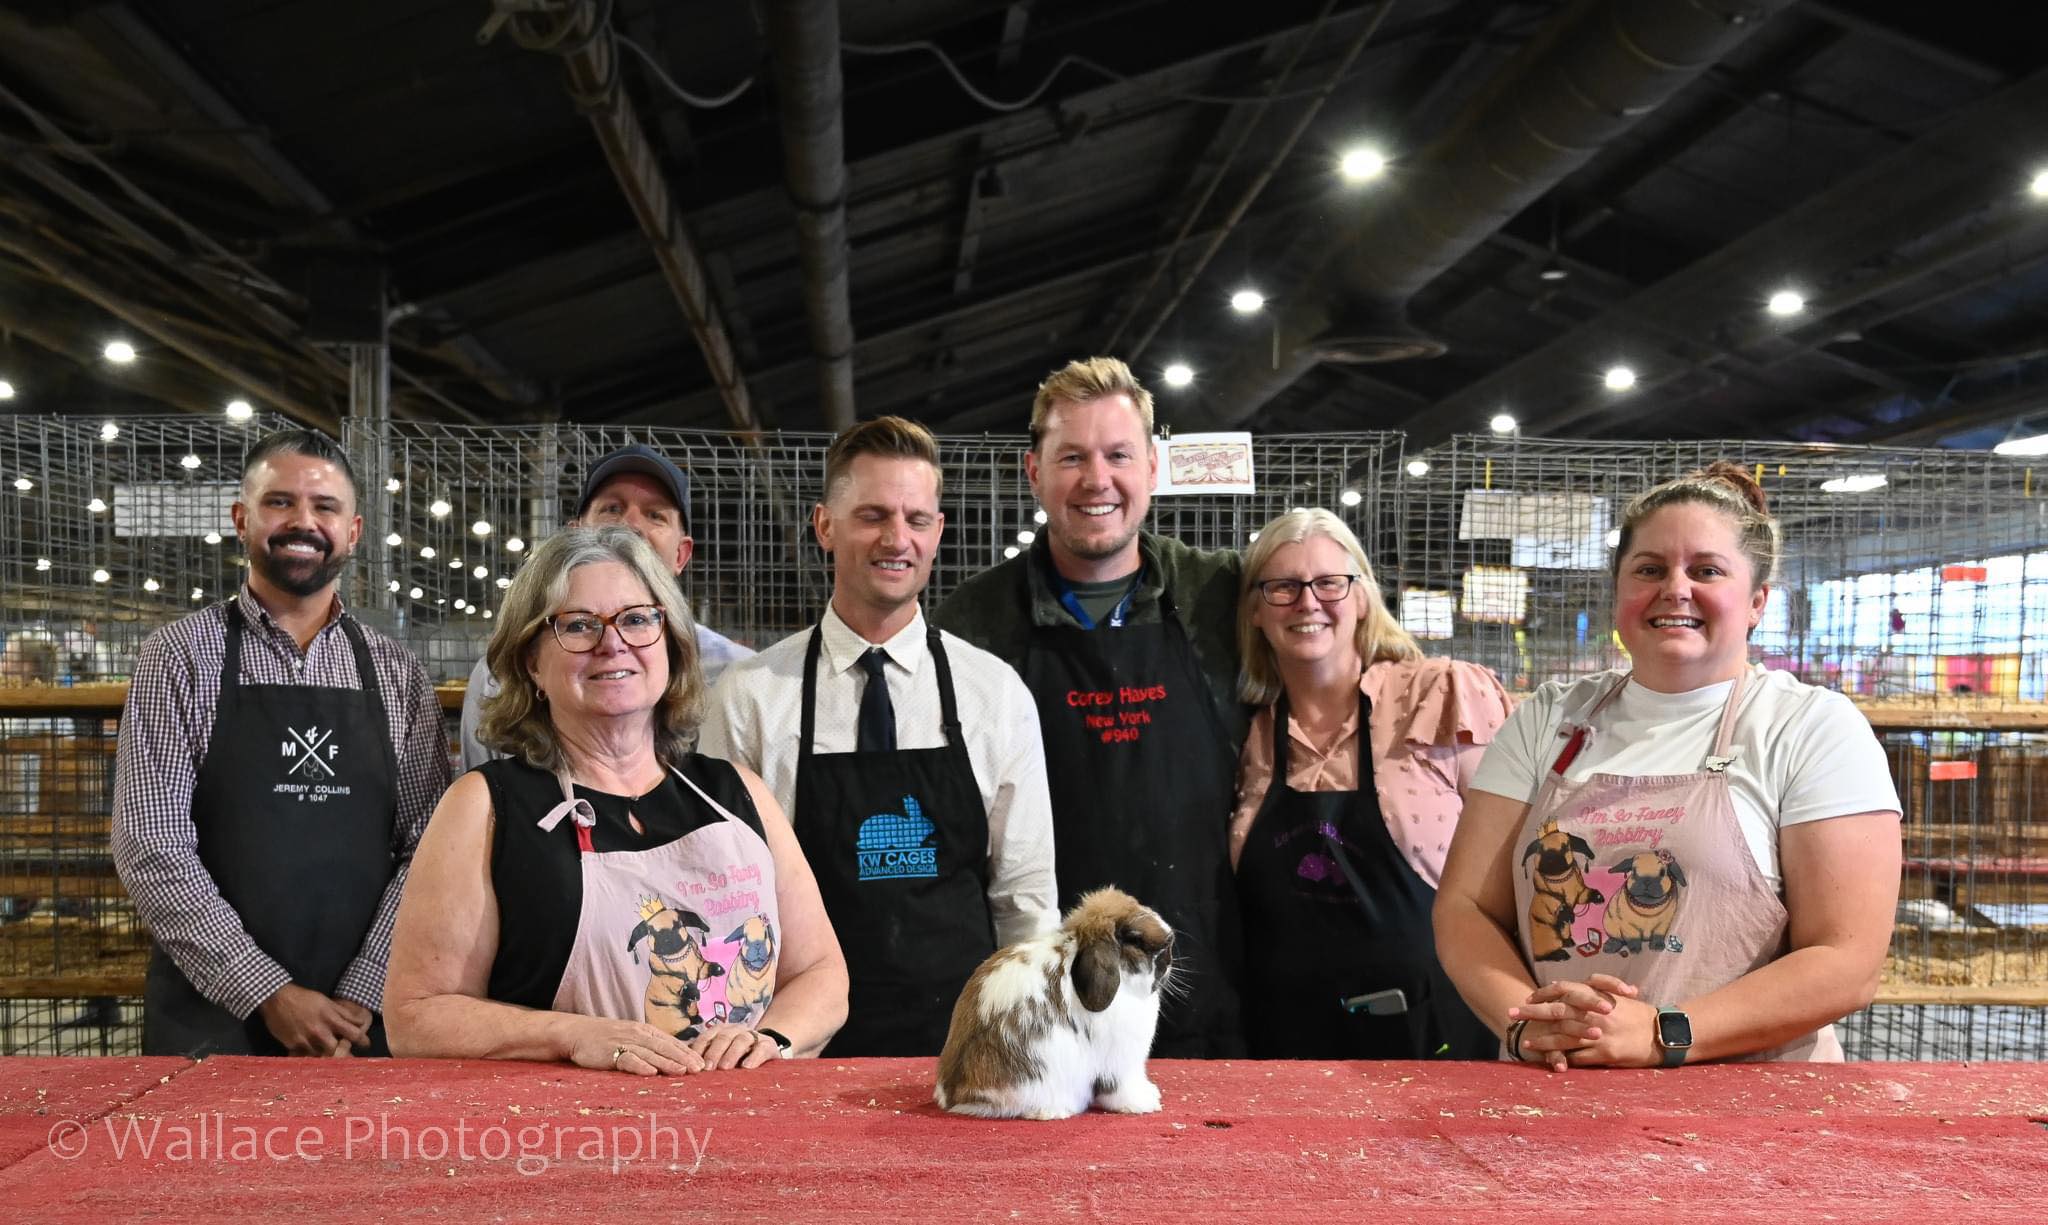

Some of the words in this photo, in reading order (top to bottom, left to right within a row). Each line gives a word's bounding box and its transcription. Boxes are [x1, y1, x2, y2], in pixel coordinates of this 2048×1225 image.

[1067, 690, 1113, 706] Corey
[1119, 685, 1166, 704] Hayes
[1086, 715, 1114, 728] New
[1119, 710, 1152, 725] York
[282, 742, 297, 756] M
[329, 745, 339, 759] F
[273, 784, 310, 793] JEREMY
[315, 785, 351, 795] COLLINS
[309, 794, 328, 802] 1047
[1635, 806, 1686, 824] Fancy
[859, 855, 881, 867] KW
[886, 851, 936, 866] CAGES
[860, 865, 906, 877] ADVANCED
[906, 863, 937, 874] DESIGN
